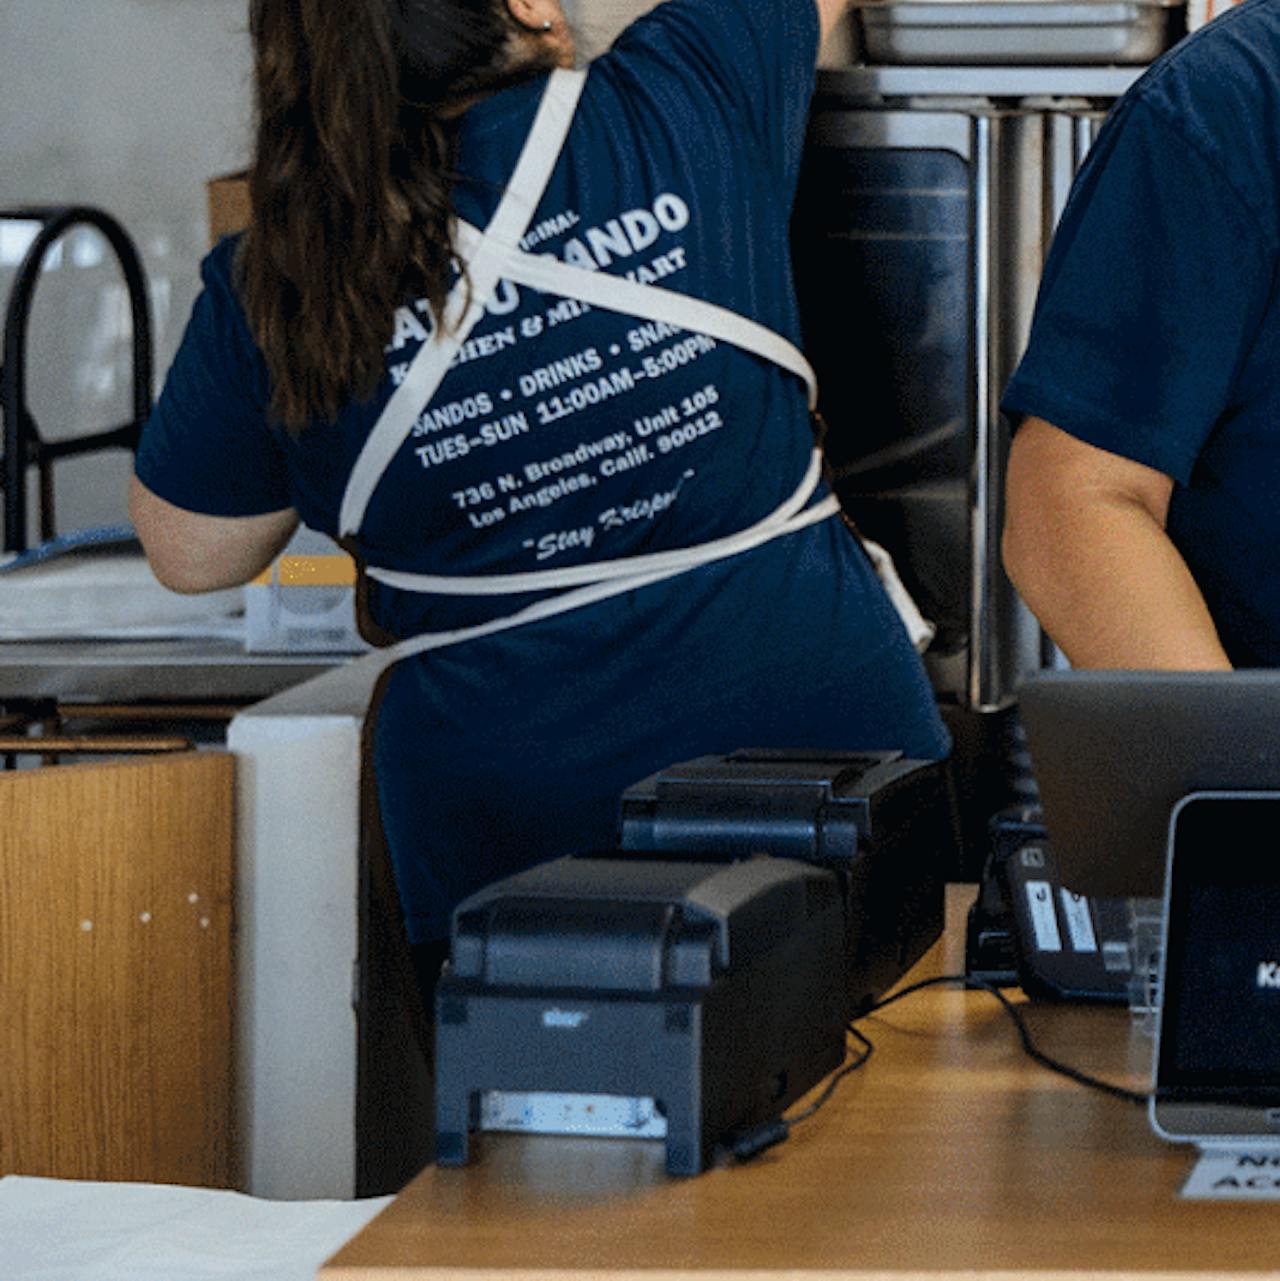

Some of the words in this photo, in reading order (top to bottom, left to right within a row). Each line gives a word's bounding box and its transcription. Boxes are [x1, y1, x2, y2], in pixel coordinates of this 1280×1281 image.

[545, 192, 690, 270] ANDO
[520, 315, 544, 338] &
[411, 391, 494, 438] SANDOS
[519, 347, 603, 397] DRINKS
[452, 482, 496, 508] 736
[498, 472, 523, 493] N.
[524, 432, 633, 482] Broadway,
[634, 406, 680, 437] Unit
[681, 384, 719, 417] 105
[468, 506, 505, 529] Los
[509, 472, 597, 514] Angeles,
[600, 443, 655, 477] Calif.
[656, 410, 724, 454] 90012
